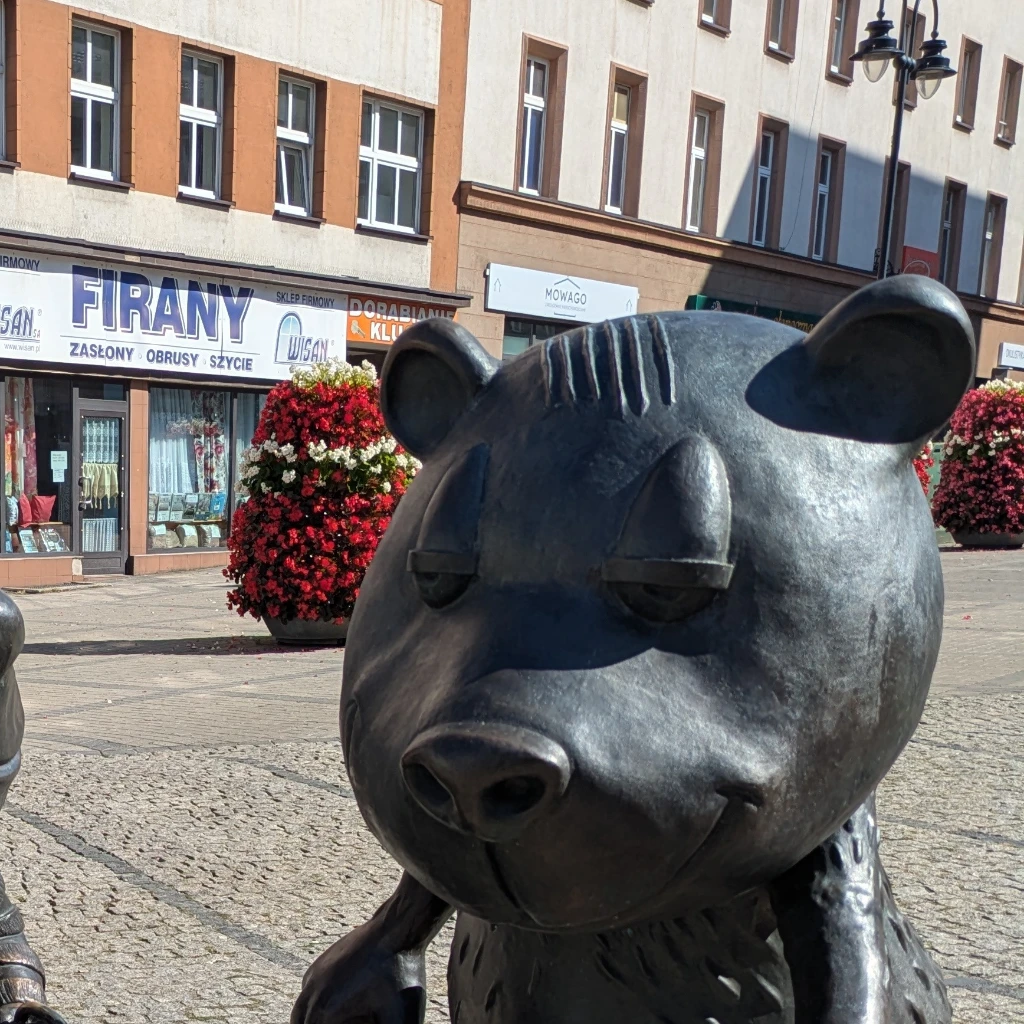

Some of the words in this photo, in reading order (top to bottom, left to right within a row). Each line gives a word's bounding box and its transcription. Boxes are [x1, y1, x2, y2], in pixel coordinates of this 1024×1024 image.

[72, 265, 255, 344] FIRANY
[276, 291, 300, 304] SKLEP
[302, 294, 334, 308] FIRMOWY
[545, 288, 587, 305] MOWAGO
[370, 321, 405, 343] KLU
[70, 342, 134, 361] ZASŁONY
[146, 349, 199, 367] OBRUSY
[209, 355, 253, 371] SZYCIE
[287, 335, 329, 362] WISAN
